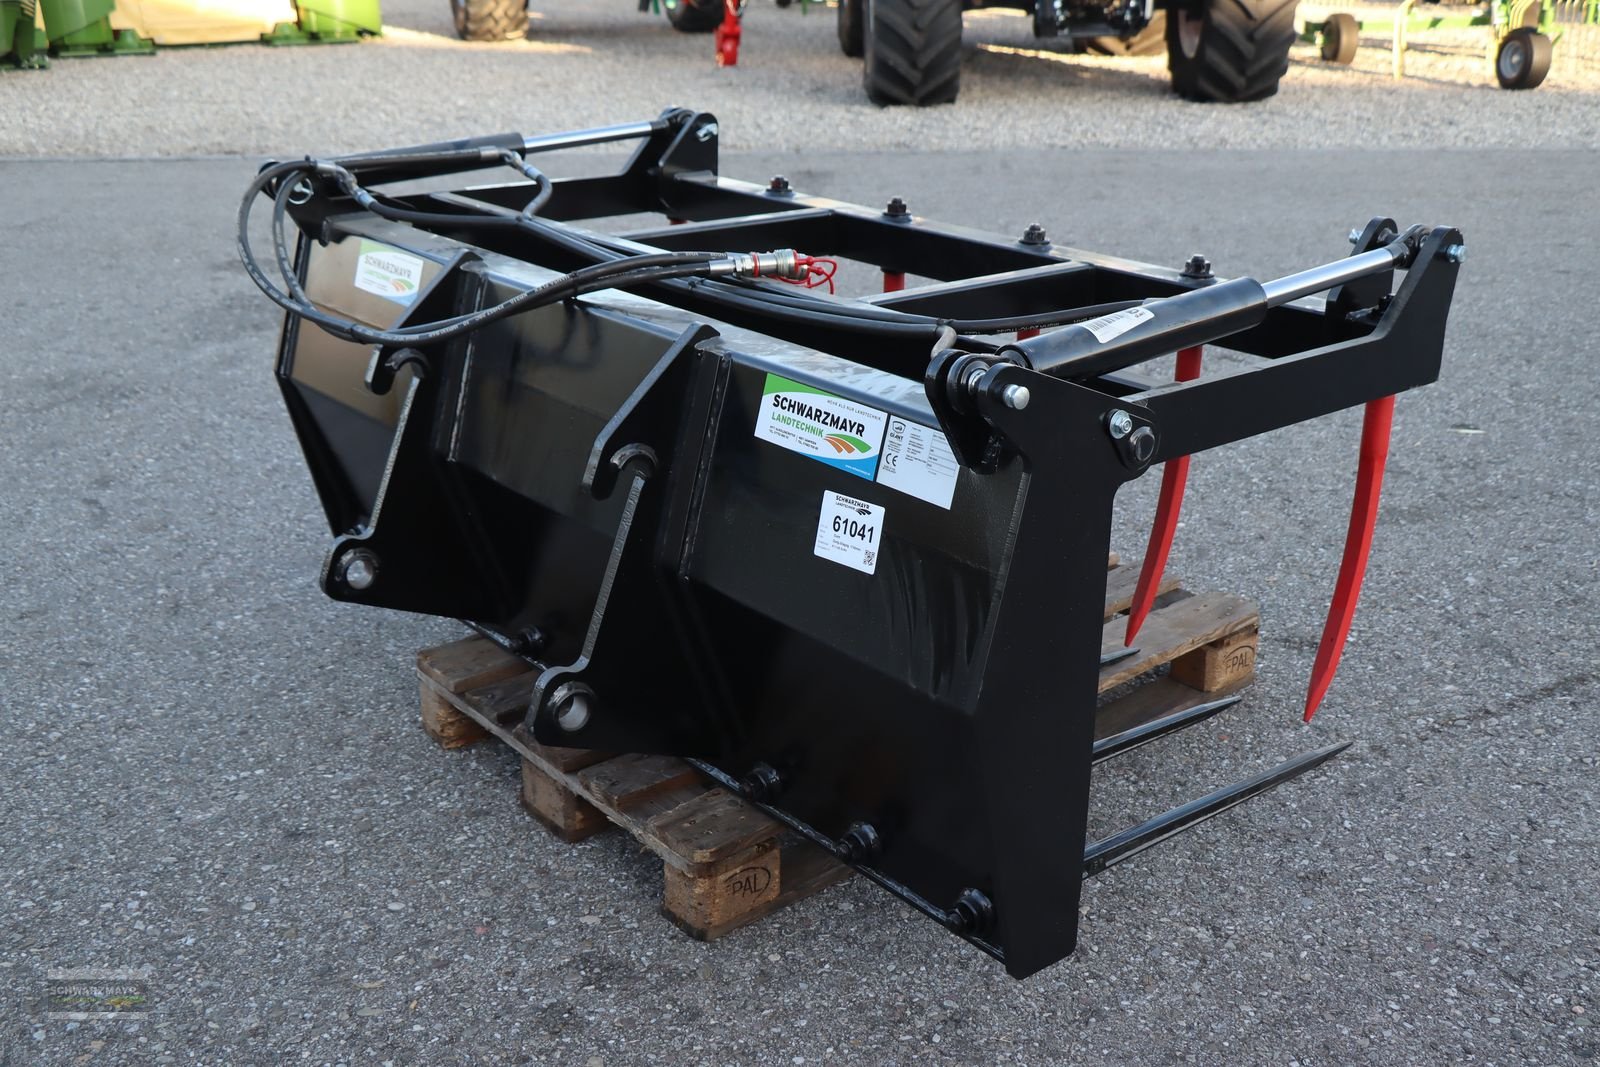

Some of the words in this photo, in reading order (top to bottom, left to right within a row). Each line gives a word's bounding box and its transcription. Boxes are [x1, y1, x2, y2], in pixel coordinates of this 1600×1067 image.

[771, 411, 824, 438] LANDTECHNIK
[772, 394, 865, 437] SCHWARZMAYR
[889, 432, 904, 441] GIANT
[835, 495, 870, 510] SCHWARZMAYR
[832, 515, 874, 543] 61041
